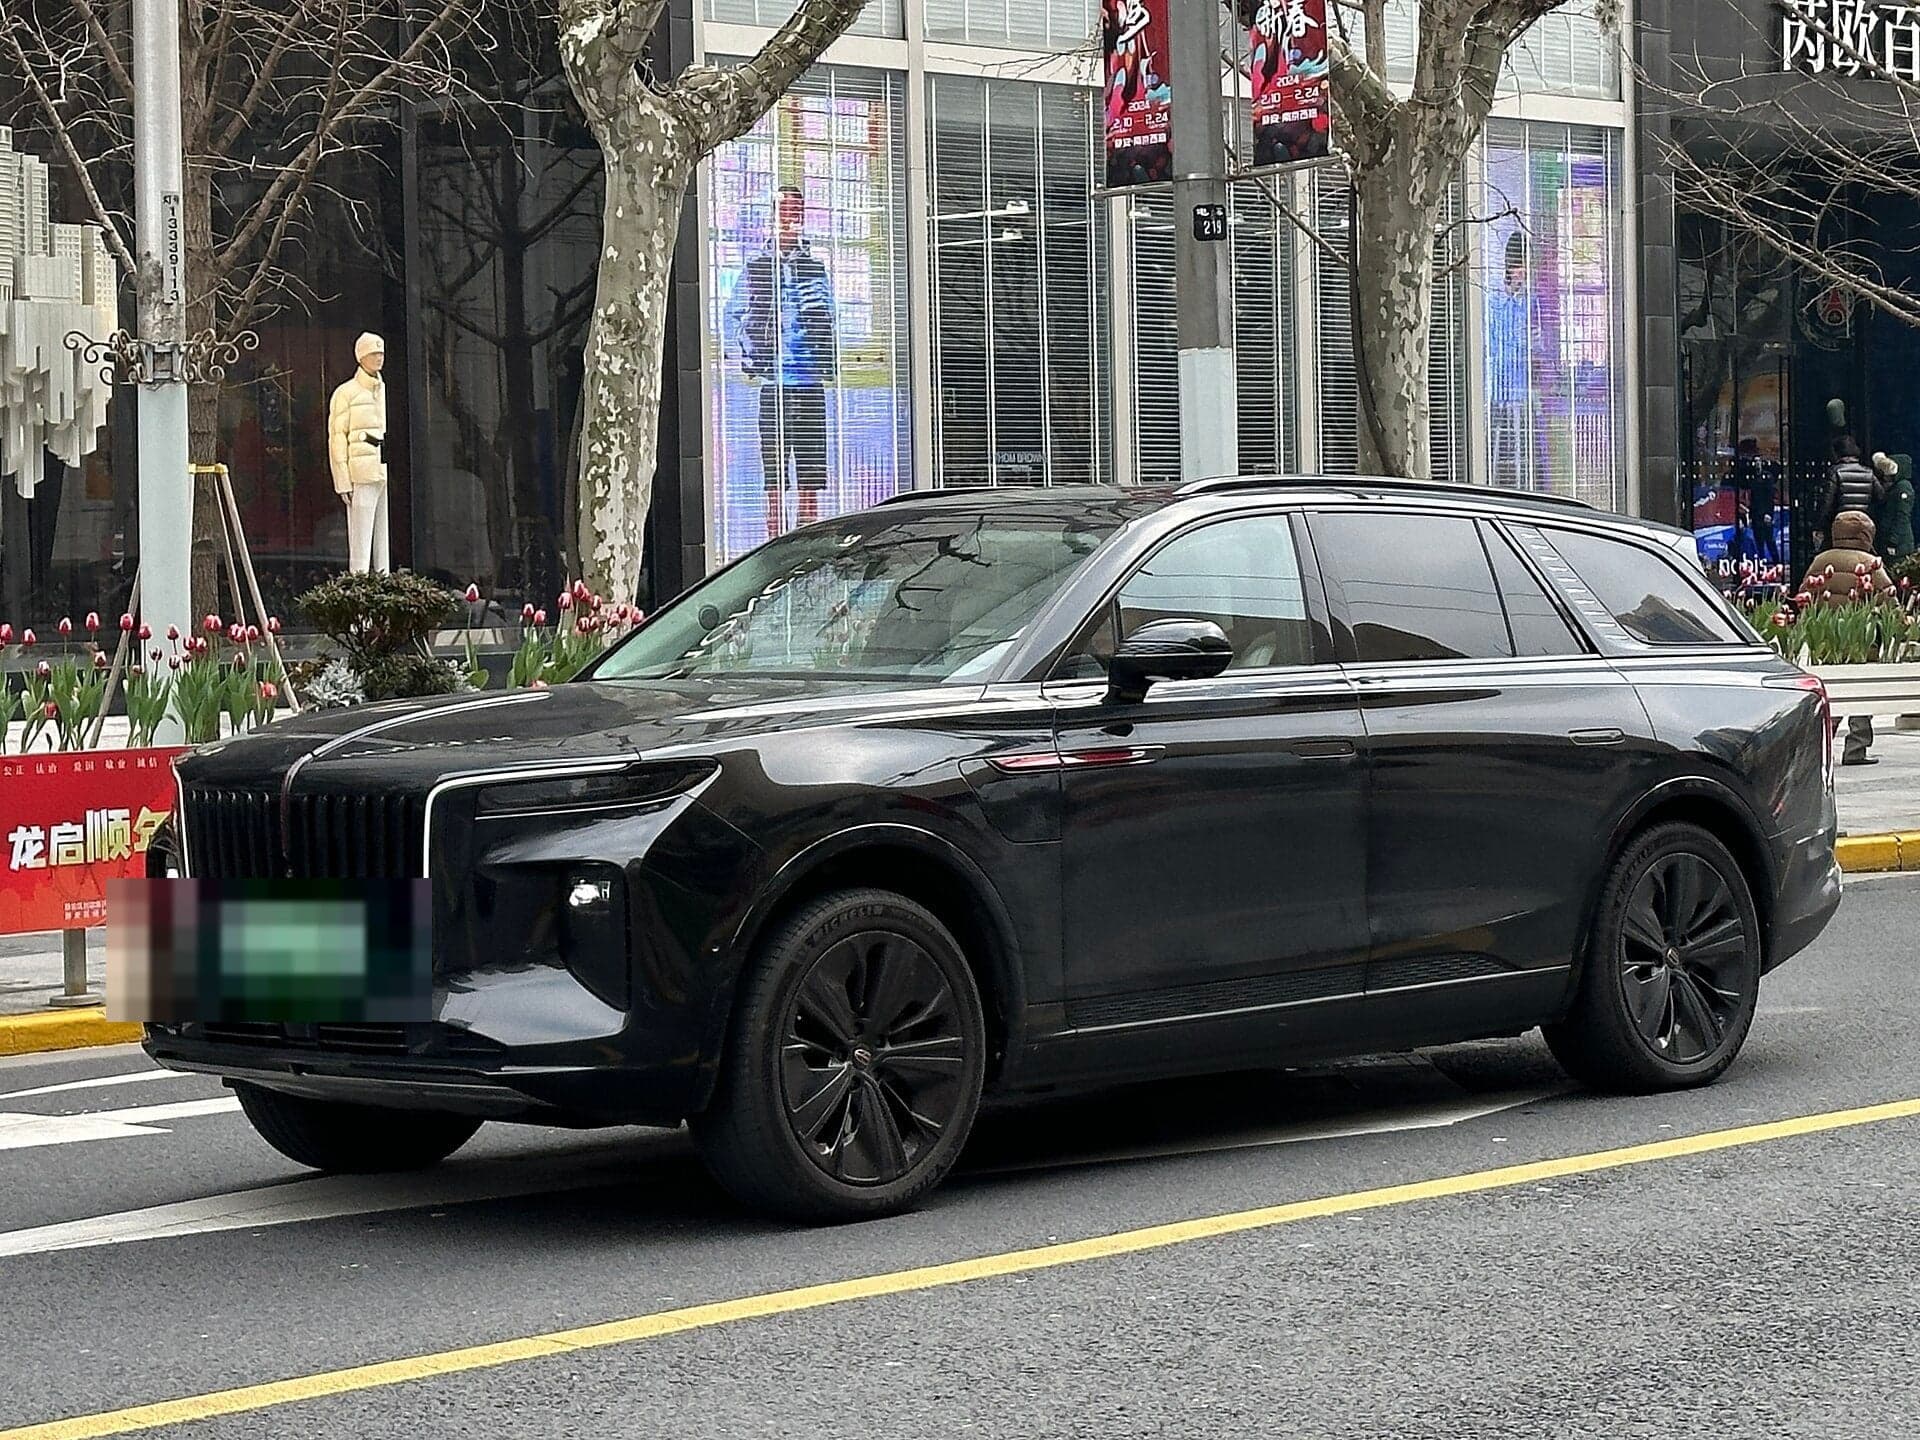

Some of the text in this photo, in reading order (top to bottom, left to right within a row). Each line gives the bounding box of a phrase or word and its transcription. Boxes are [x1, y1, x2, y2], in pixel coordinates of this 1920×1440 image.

[1256, 0, 1319, 43] 新春
[1783, 0, 1920, 81] 芮欧百
[1276, 75, 1299, 87] 2024
[1295, 87, 1319, 100] 2.24
[1128, 101, 1150, 111] 2024
[1203, 220, 1222, 235] 219
[167, 206, 180, 301] 13339113
